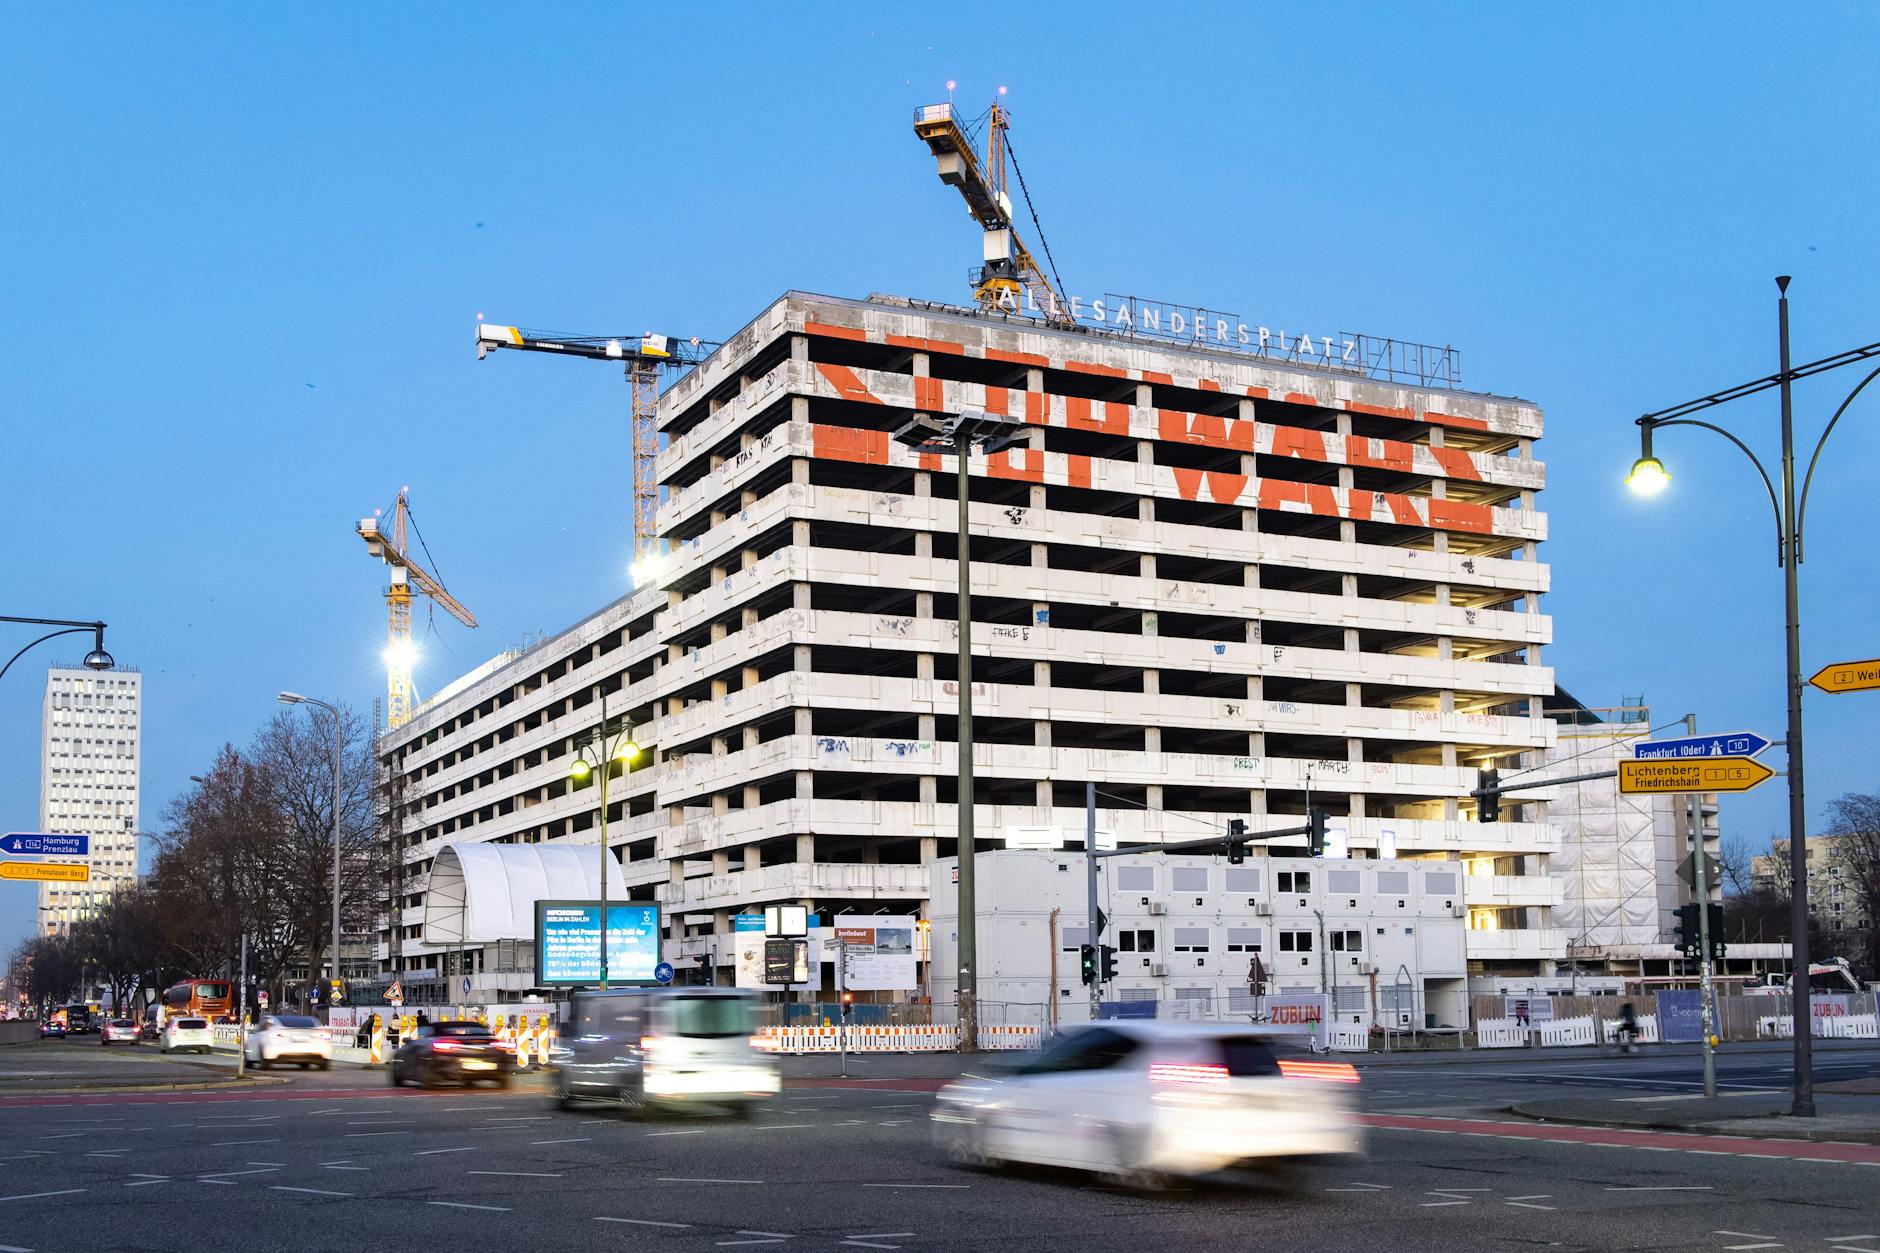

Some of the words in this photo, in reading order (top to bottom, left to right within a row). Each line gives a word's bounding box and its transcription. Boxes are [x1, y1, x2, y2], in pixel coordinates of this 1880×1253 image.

[997, 284, 1356, 361] ALLESANDERSPLATZ
[1841, 673, 1847, 682] 2
[1639, 749, 1677, 759] Frankfurt
[1680, 744, 1706, 756] (Oder)
[1734, 741, 1743, 750] 10
[1627, 766, 1700, 778] Lichtenberg
[1736, 769, 1742, 778] 5
[1635, 776, 1700, 788] Friedrichshain
[43, 837, 80, 846] Hamburg
[43, 845, 78, 853] Prenzlau
[36, 868, 68, 876] Prenzlauer
[70, 869, 85, 878] Berg
